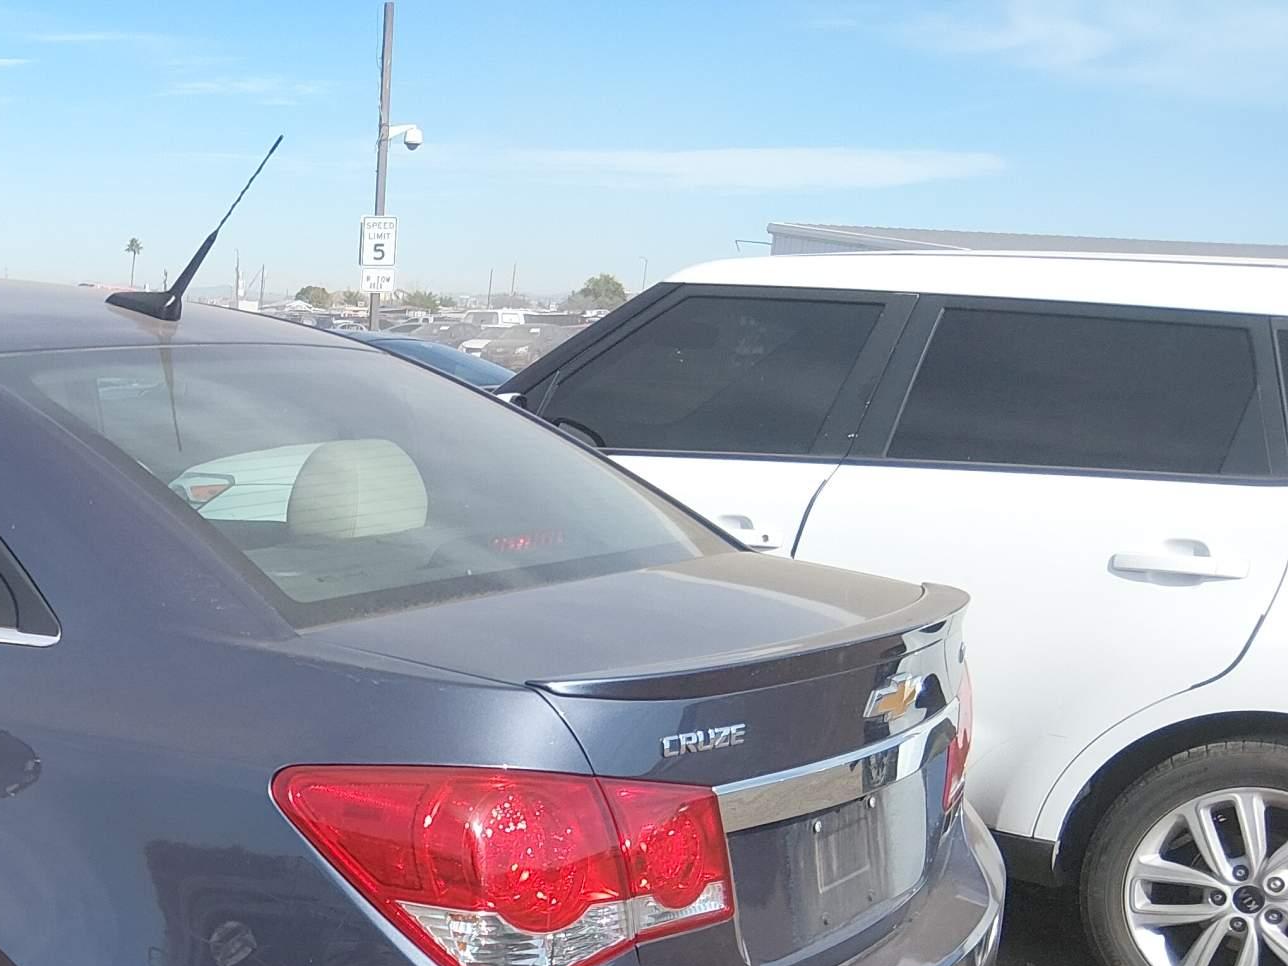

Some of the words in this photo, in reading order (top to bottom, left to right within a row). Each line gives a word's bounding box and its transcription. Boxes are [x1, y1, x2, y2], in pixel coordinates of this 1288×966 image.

[366, 221, 394, 230] SPEED
[368, 232, 391, 240] LIMIT
[373, 243, 385, 261] 5
[661, 723, 746, 758] CRUZE
